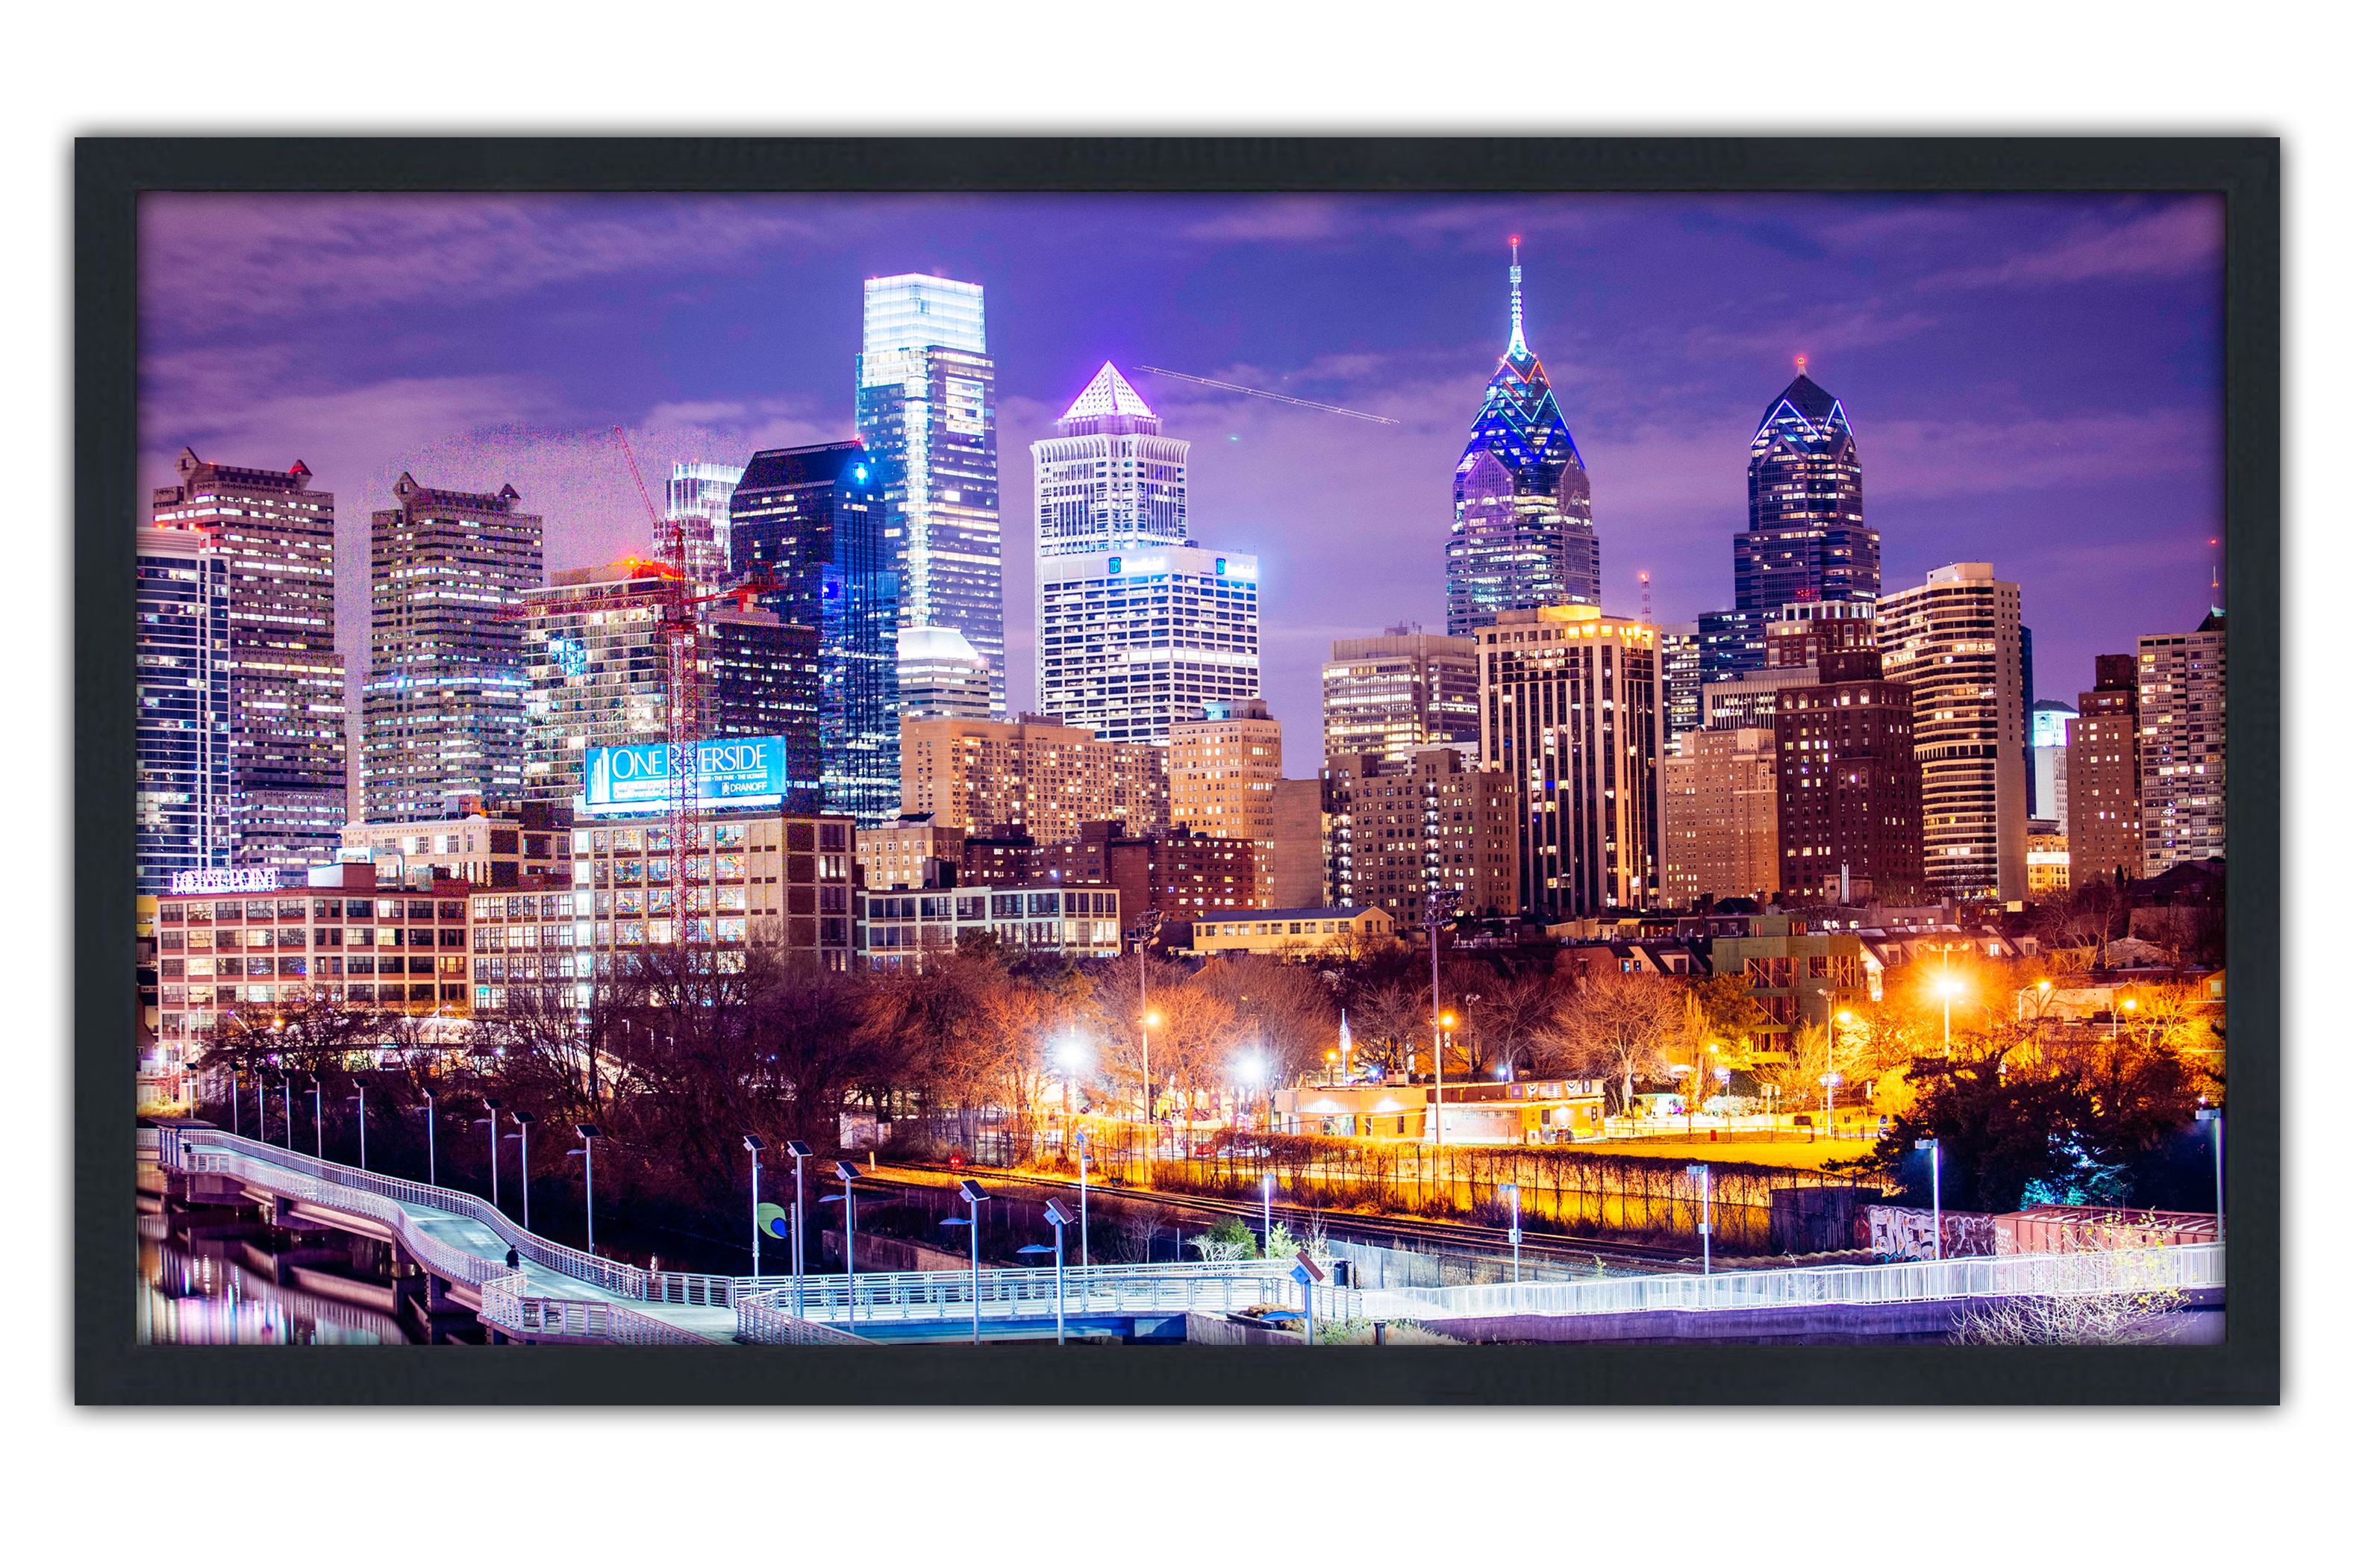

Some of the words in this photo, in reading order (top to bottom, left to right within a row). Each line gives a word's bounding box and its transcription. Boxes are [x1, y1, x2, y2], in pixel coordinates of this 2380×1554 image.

[612, 749, 663, 779] ONE
[730, 781, 768, 793] DRANOFF
[229, 867, 281, 890] POINT
